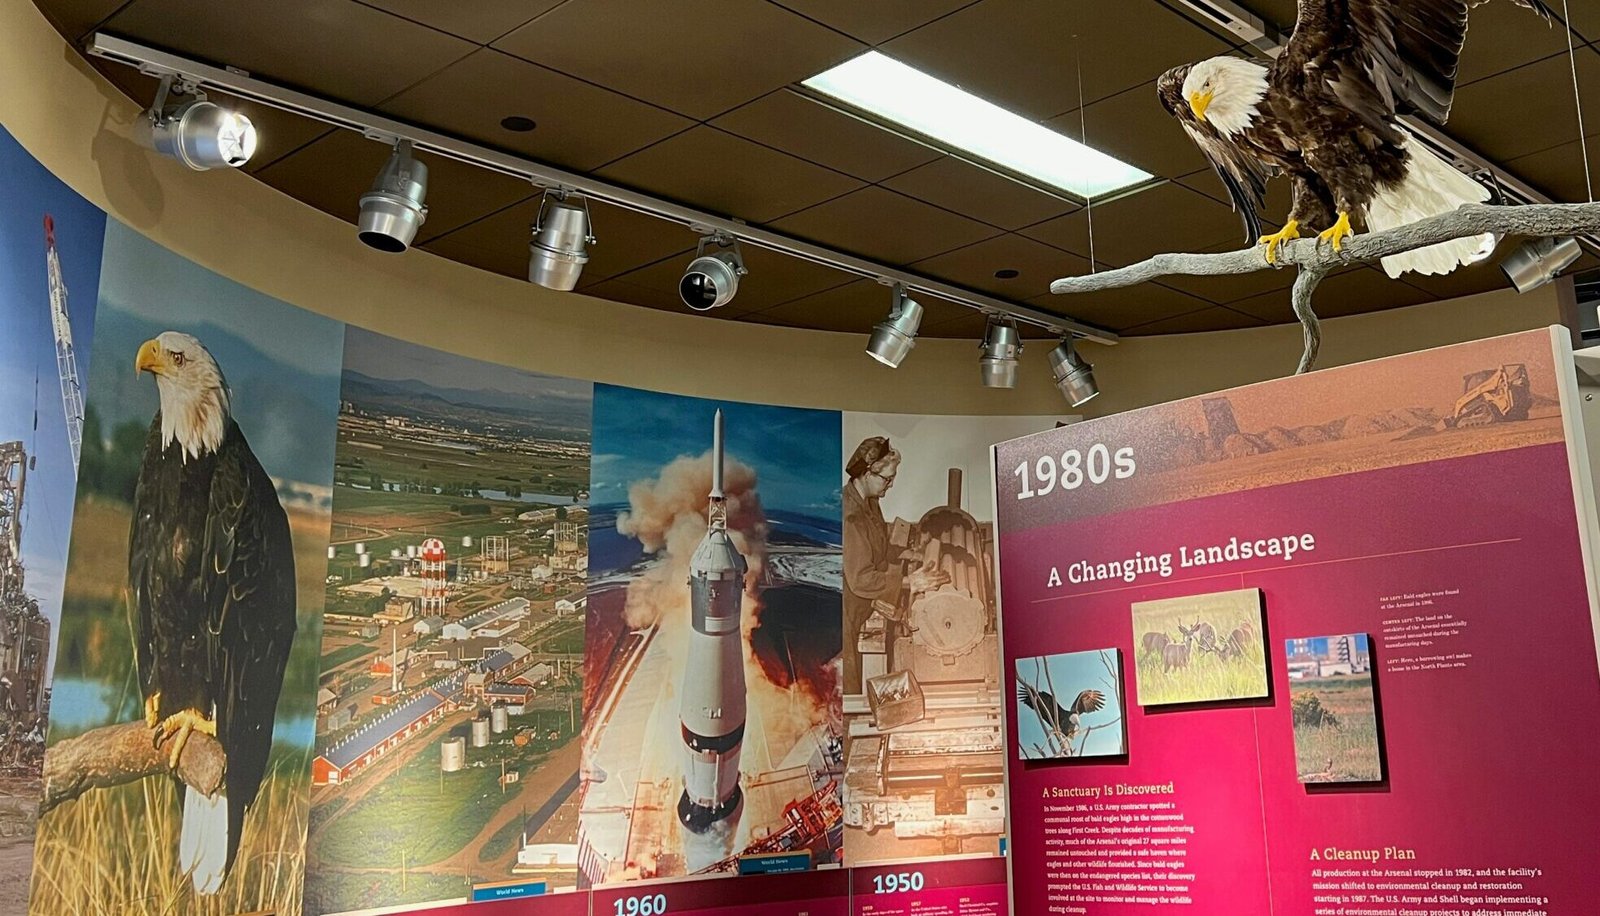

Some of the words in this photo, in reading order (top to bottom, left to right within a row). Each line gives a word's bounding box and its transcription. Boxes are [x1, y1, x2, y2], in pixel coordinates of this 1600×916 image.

[1014, 443, 1136, 500] 1980s
[1047, 567, 1062, 587] A
[1068, 551, 1173, 582] Changing
[1179, 533, 1315, 568] Landscape
[1042, 787, 1050, 798] A
[1052, 787, 1101, 799] Sanctuary
[1104, 784, 1113, 796] Is
[1116, 781, 1174, 795] Discovered
[1310, 848, 1320, 860] A
[1324, 847, 1380, 862] Cleanup
[1384, 847, 1416, 860] Plan
[1323, 869, 1361, 878] production
[1414, 869, 1444, 878] stopped
[1445, 868, 1453, 876] in
[1455, 868, 1475, 877] 1982,
[1476, 868, 1491, 876] and
[1492, 868, 1506, 876] the
[1508, 868, 1542, 878] facility's
[873, 871, 924, 894] 1950
[1431, 882, 1462, 891] cleanup
[1463, 882, 1478, 890] and
[1479, 882, 1523, 890] restoration
[613, 894, 666, 916] 1960
[1314, 895, 1341, 904] starting
[1401, 896, 1422, 904] Army
[1439, 895, 1459, 903] Shell
[1460, 895, 1484, 905] began
[1485, 895, 1542, 905] implementing
[1336, 908, 1344, 916] of
